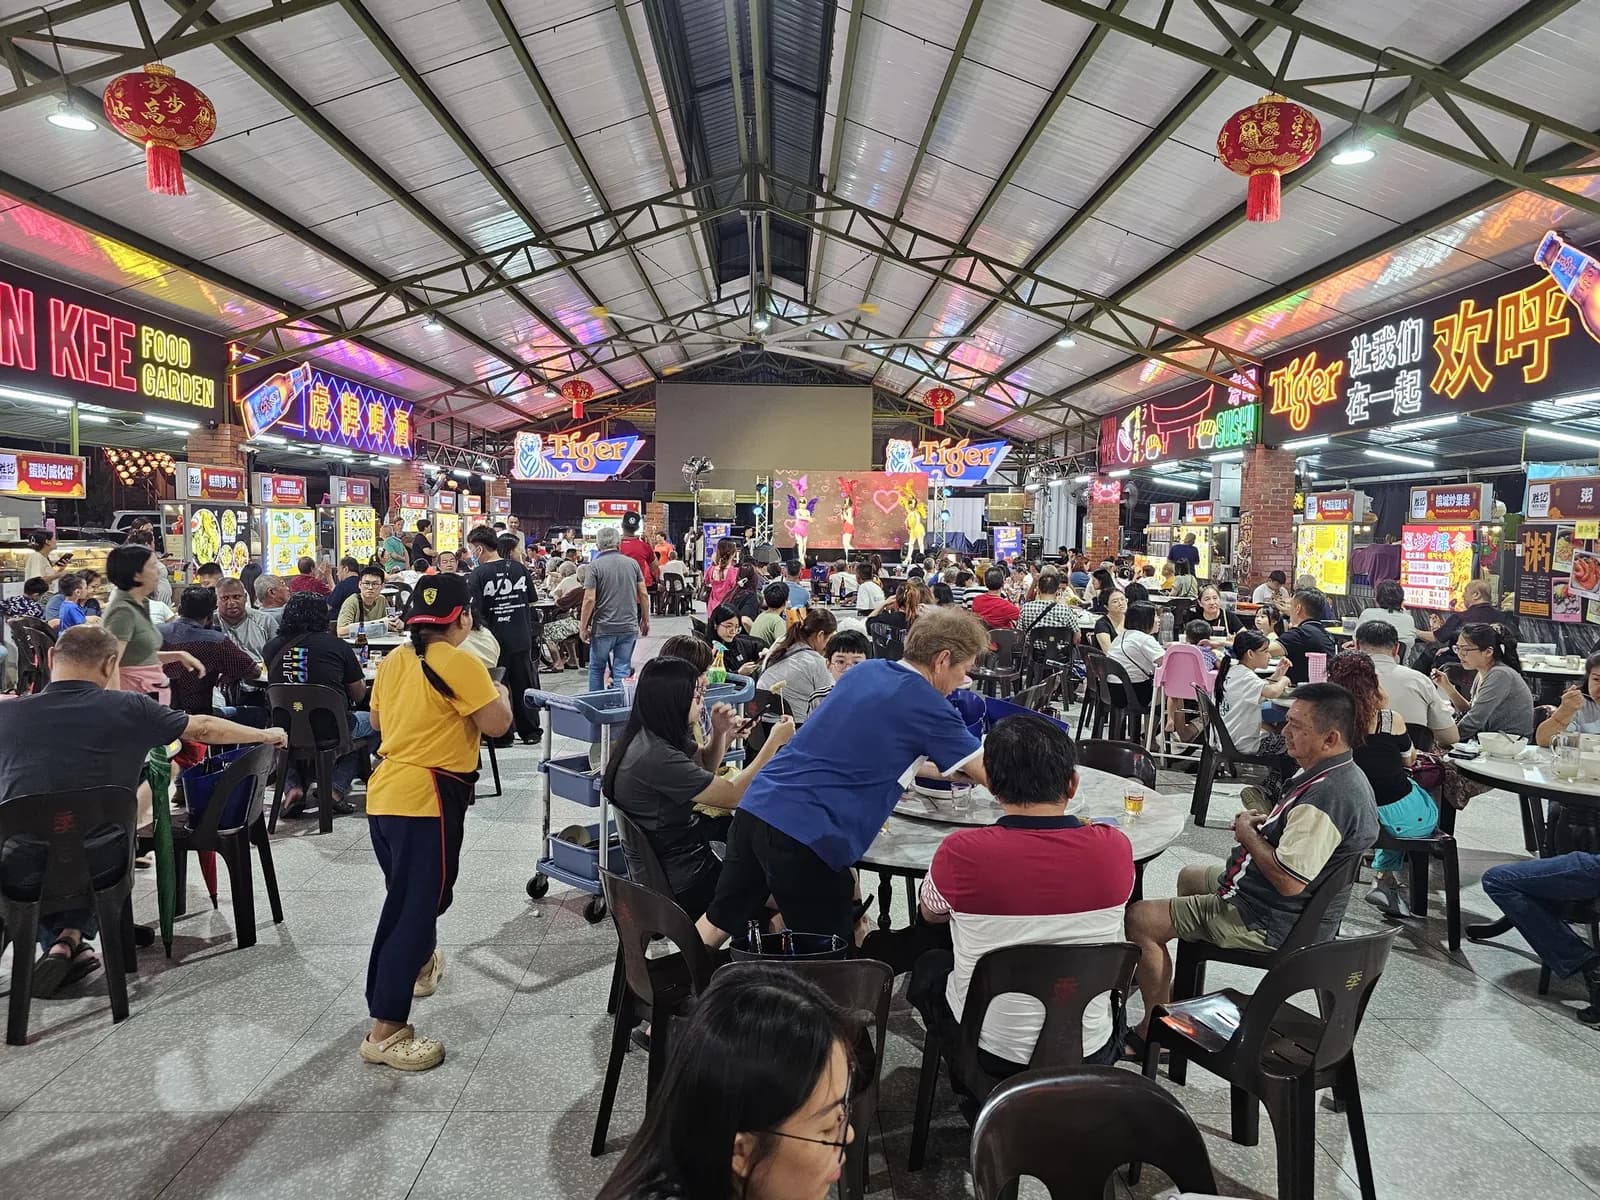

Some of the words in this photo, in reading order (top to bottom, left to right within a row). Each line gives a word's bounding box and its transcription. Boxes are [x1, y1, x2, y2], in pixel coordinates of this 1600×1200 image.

[50, 298, 137, 392] KEE
[141, 325, 191, 369] FOOD
[1347, 317, 1424, 379] 让我们
[1430, 273, 1571, 400] 欢呼
[142, 363, 215, 409] GARDEN
[1268, 351, 1344, 432] Tiger
[1345, 368, 1422, 426] 在一起
[310, 382, 409, 449] 虎牌啤酒
[1215, 404, 1255, 448] SUSHI
[547, 431, 628, 472] Tiger
[918, 438, 996, 478] Tiger
[1580, 487, 1594, 503] 粥
[1522, 531, 1552, 573] 粥
